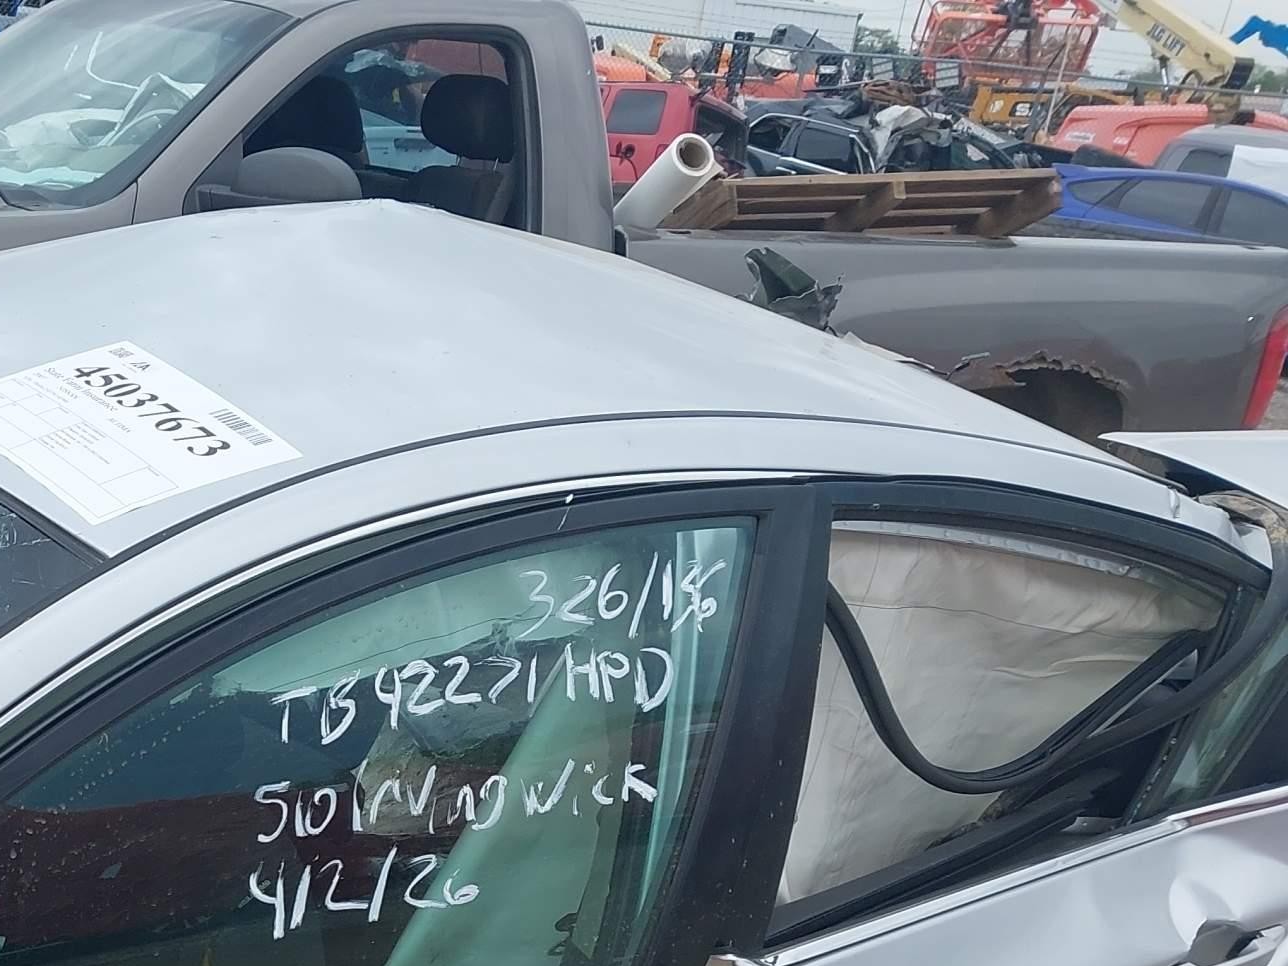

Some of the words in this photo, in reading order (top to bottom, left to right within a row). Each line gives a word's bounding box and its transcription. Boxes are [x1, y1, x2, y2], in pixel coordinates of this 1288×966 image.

[1162, 34, 1186, 56] LIFT
[44, 367, 65, 379] State
[80, 388, 119, 412] Insurance
[74, 367, 231, 457] 45037673
[249, 843, 480, 940] 4/2/26
